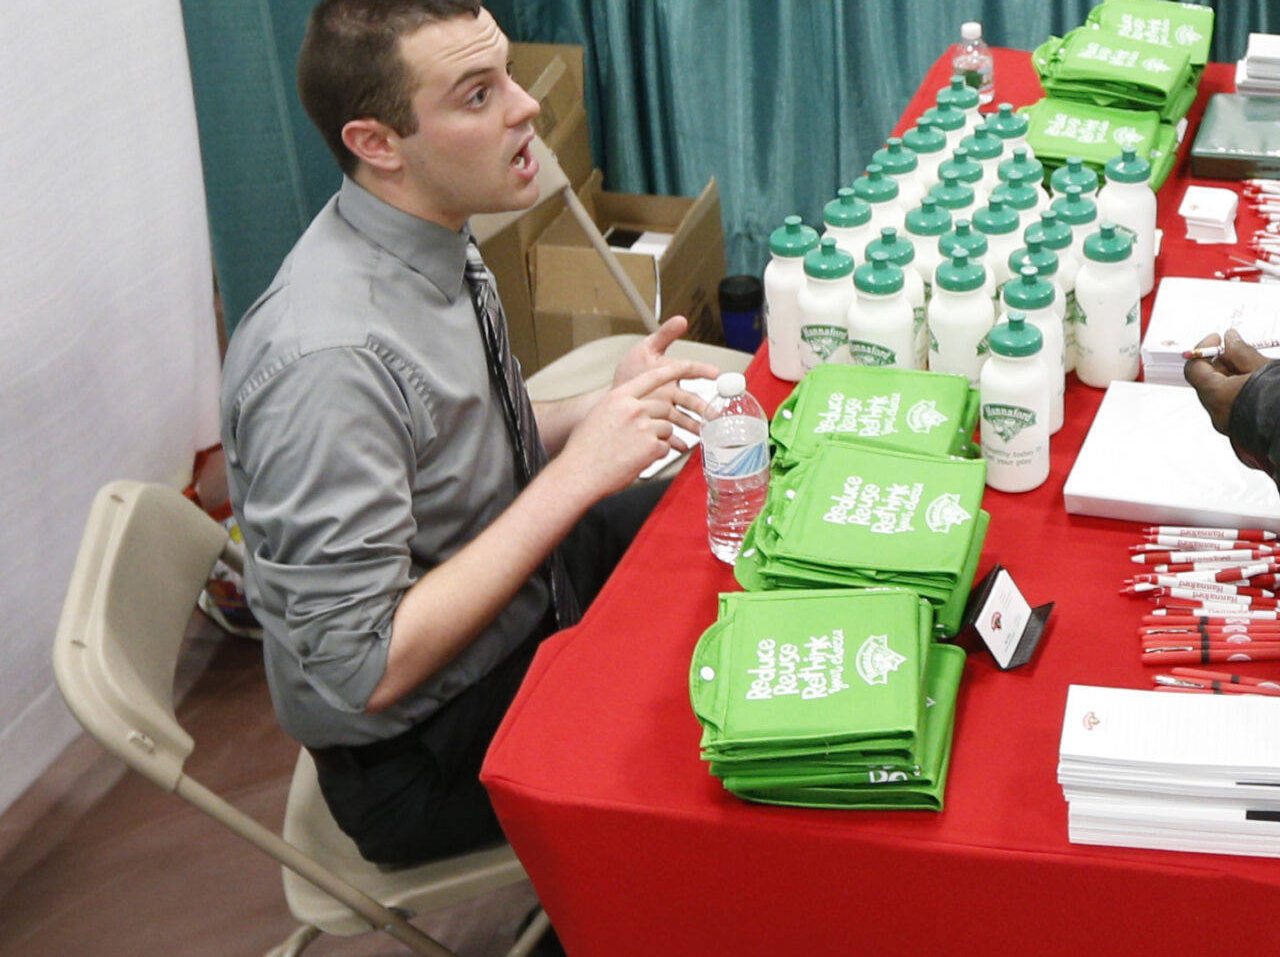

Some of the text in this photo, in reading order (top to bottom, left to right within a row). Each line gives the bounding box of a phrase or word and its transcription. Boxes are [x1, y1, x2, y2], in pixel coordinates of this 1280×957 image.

[814, 392, 845, 434] Reduce
[836, 397, 863, 433] Reuse
[858, 395, 889, 437] Rethink
[984, 405, 1033, 422] Hannaford
[822, 475, 863, 525] Reduce
[847, 483, 881, 526] Reuse
[870, 482, 910, 534] Rethink
[745, 638, 776, 700] Reduce
[773, 643, 800, 696] Reuse
[797, 634, 831, 700] Rethink
